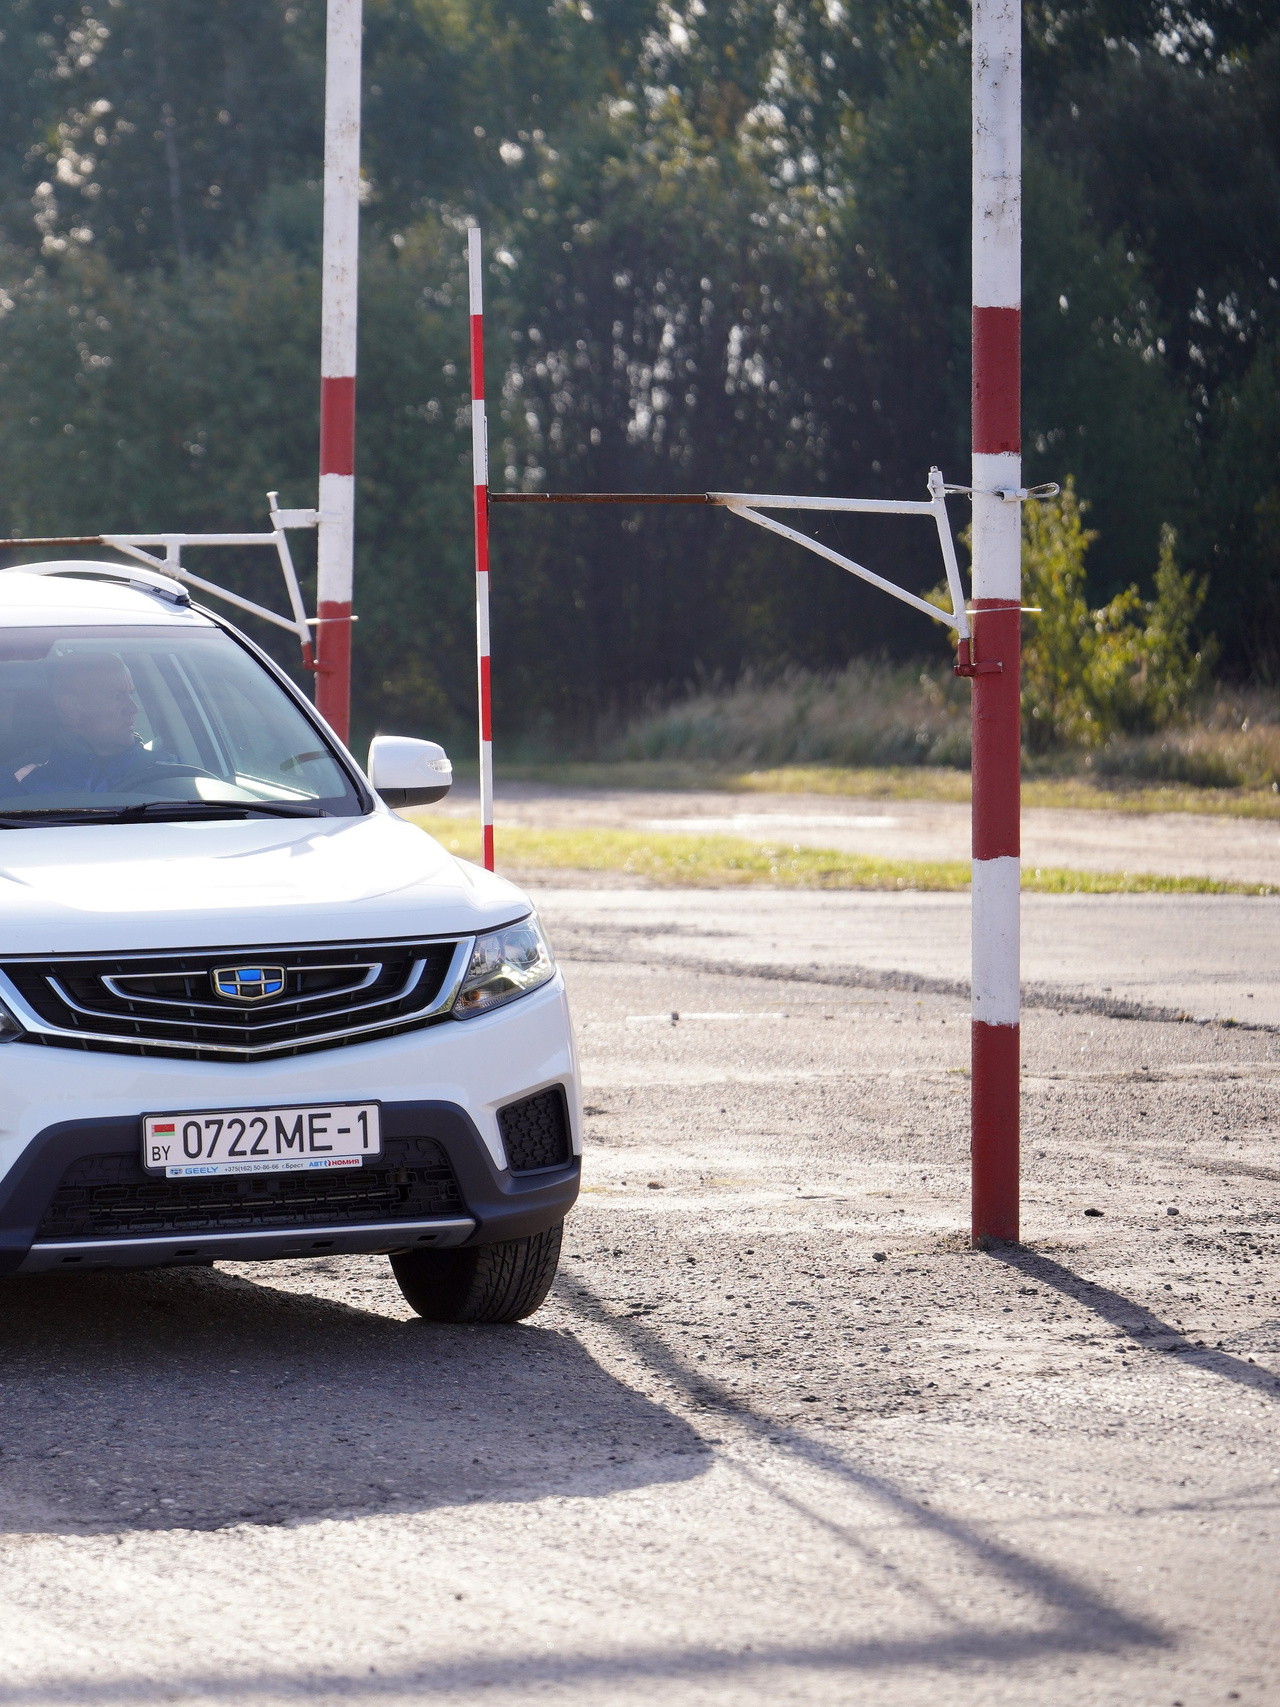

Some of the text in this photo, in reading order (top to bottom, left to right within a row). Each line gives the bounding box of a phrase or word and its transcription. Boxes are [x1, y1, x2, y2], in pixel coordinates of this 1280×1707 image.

[152, 1145, 171, 1161] BY
[185, 1166, 218, 1174] GEELY
[281, 1162, 304, 1170] г.Брест
